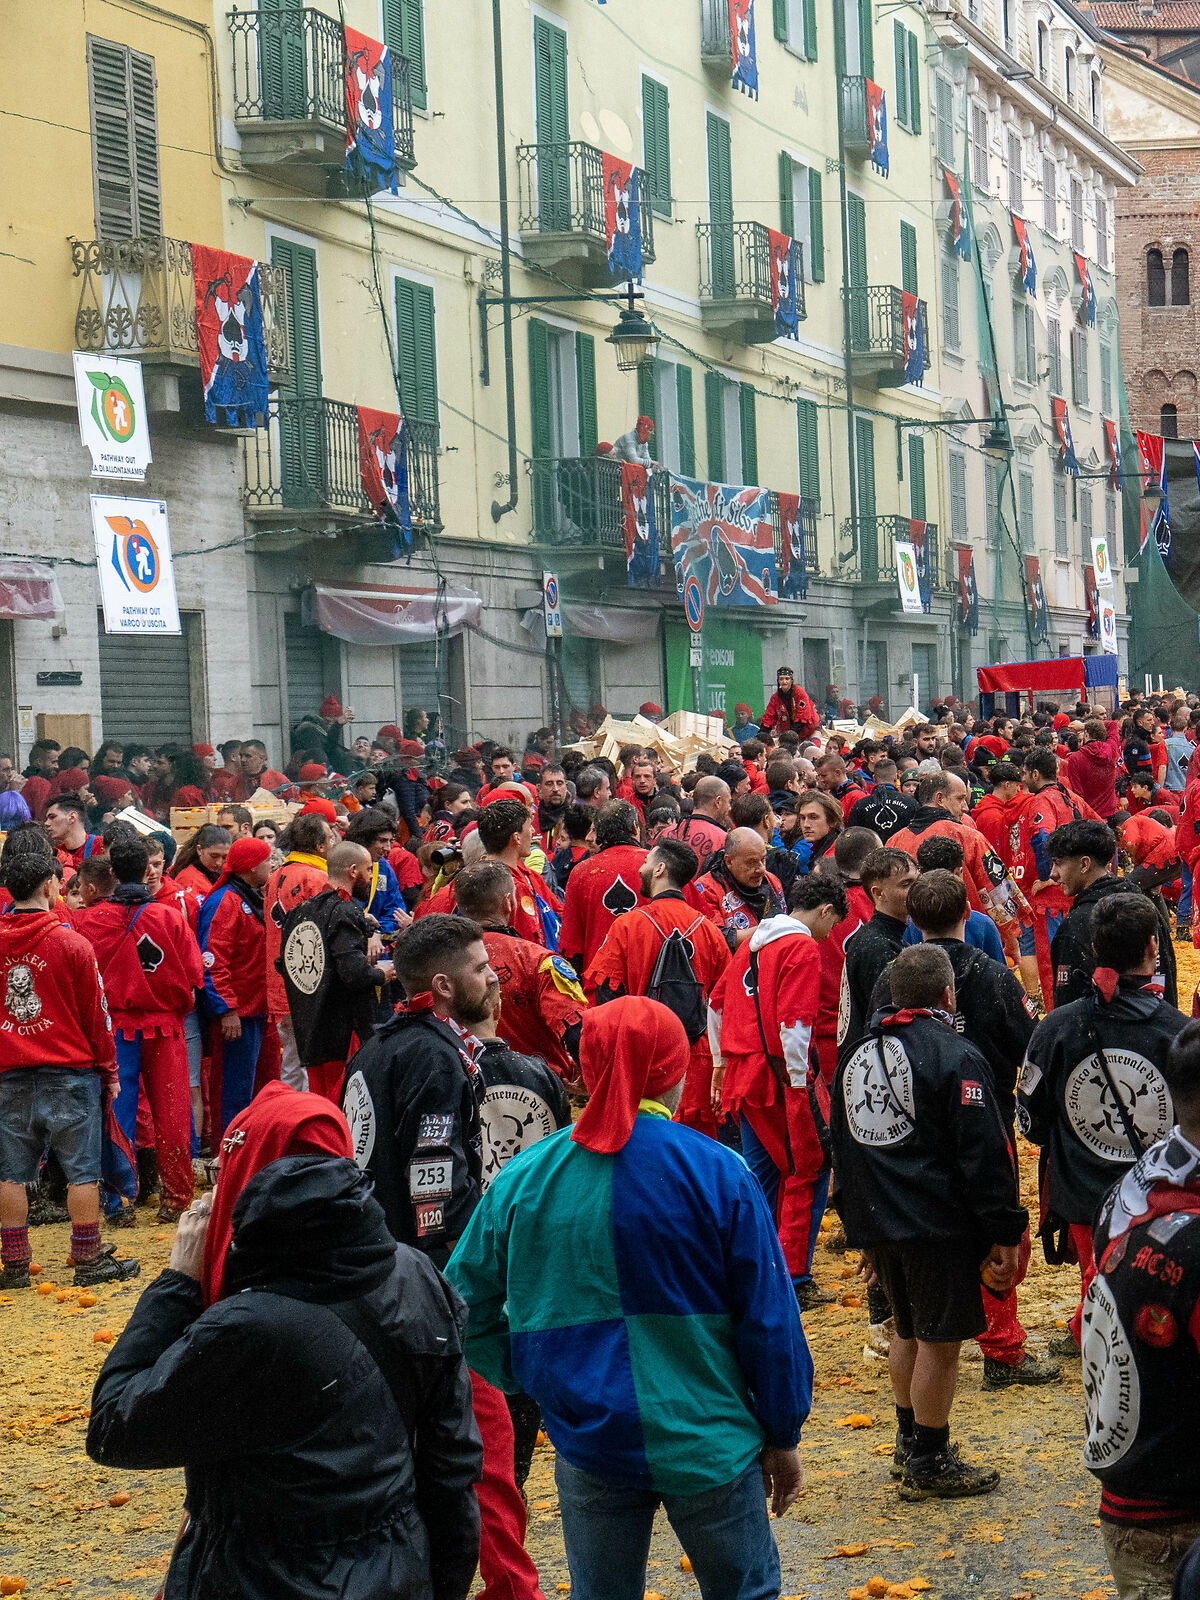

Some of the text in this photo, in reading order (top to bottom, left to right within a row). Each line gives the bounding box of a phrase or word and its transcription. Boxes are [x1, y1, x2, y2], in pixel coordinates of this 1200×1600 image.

[100, 453, 136, 464] PATHWAY OUT
[122, 606, 161, 615] PATHWAY OUT
[120, 619, 141, 627] VARCO
[845, 1055, 862, 1097] Storico
[1069, 1068, 1090, 1110] Storico
[1090, 1054, 1147, 1074] Crnevale
[965, 1086, 983, 1100] 313
[417, 1167, 445, 1186] 253
[418, 1209, 443, 1227] 1120
